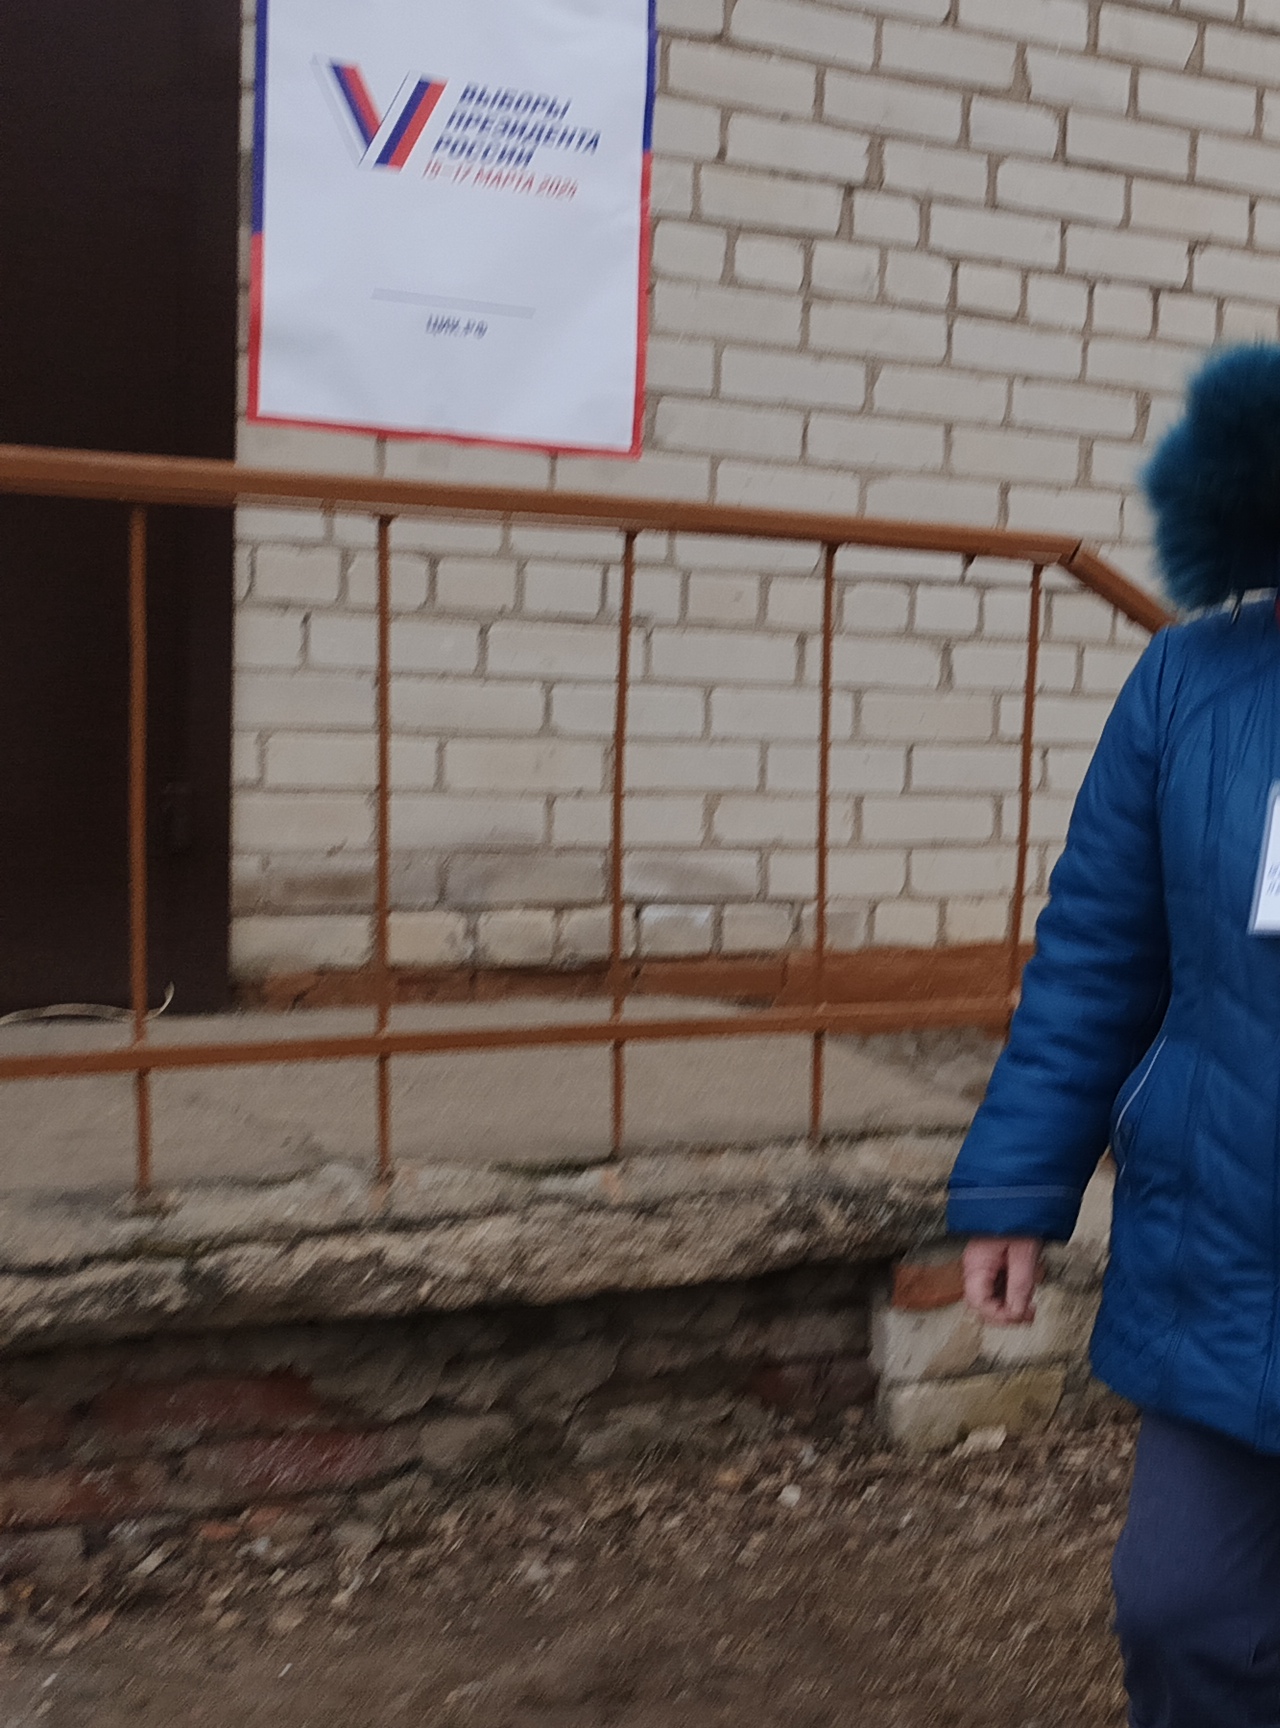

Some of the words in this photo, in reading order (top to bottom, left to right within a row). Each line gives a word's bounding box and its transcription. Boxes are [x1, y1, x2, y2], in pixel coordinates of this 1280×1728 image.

[460, 82, 572, 119] ВЫБОРЫ
[446, 110, 601, 154] ПРЕЗИДЕНТА
[433, 136, 536, 168] РОССИИ
